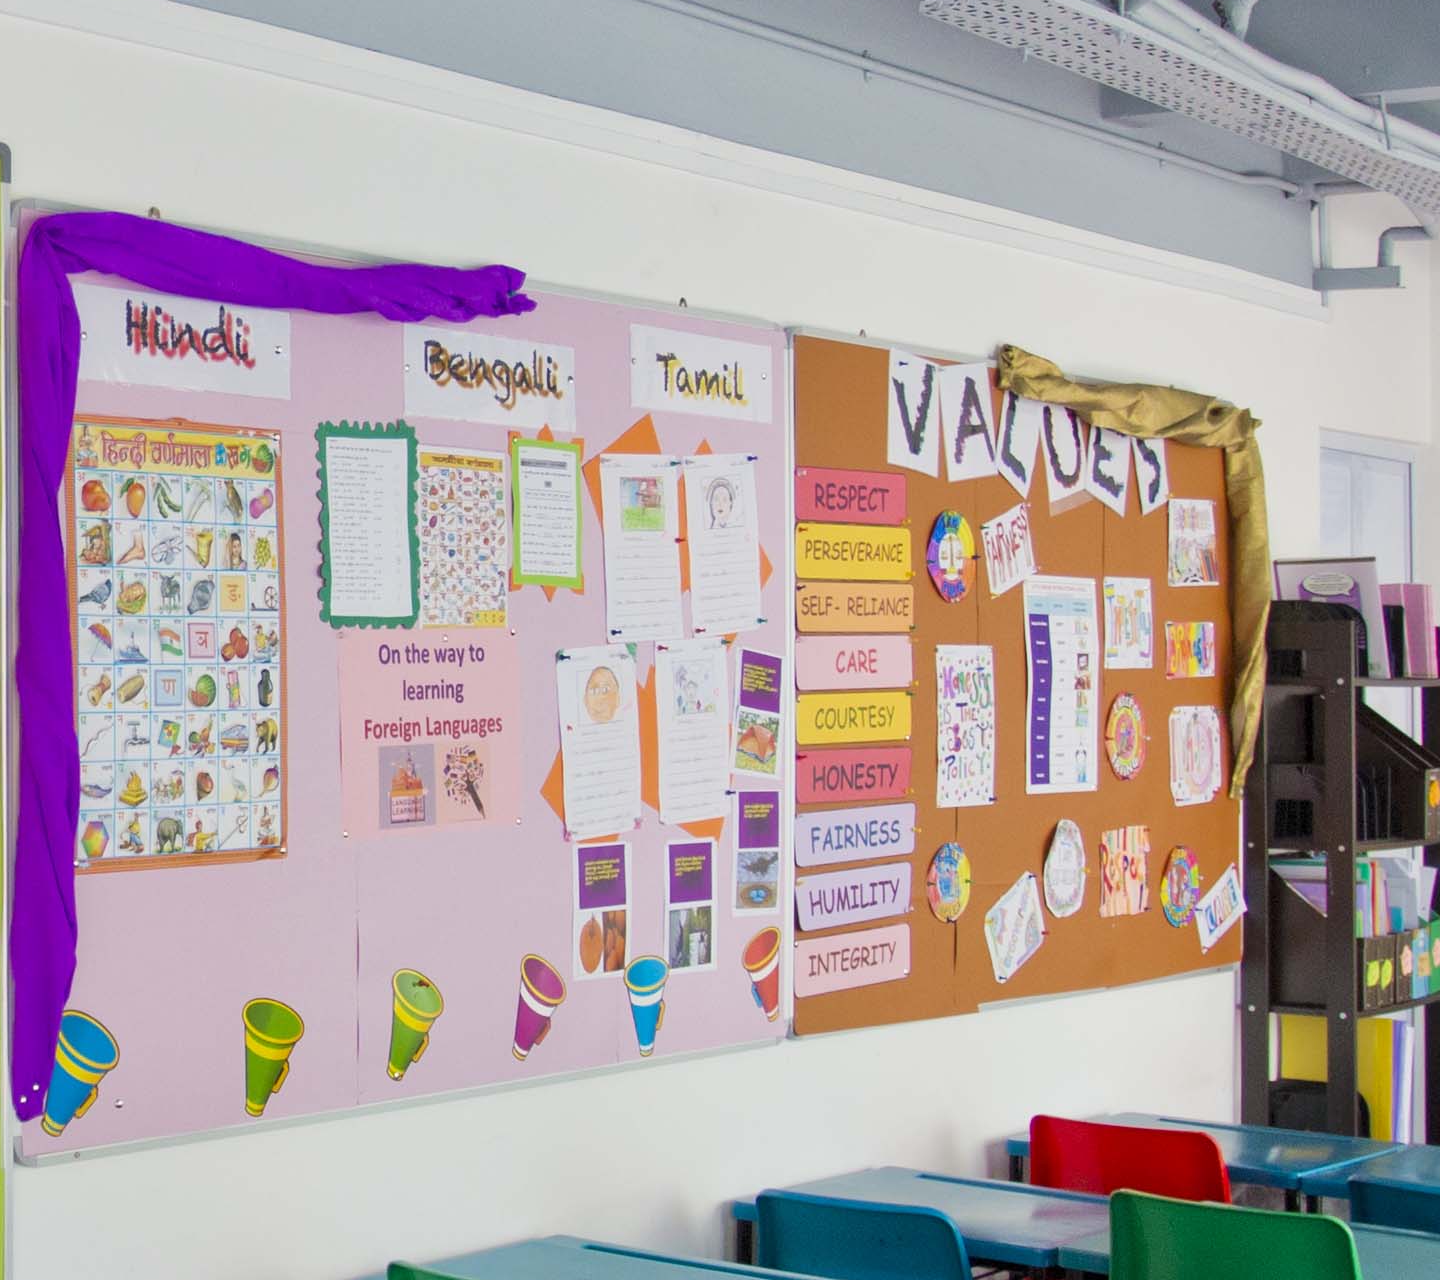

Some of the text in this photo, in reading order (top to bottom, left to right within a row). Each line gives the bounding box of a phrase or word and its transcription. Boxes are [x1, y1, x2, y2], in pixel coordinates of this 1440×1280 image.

[126, 299, 255, 368] Hindi
[424, 340, 562, 410] Bengali
[656, 352, 747, 405] Tamil
[892, 364, 1161, 504] VALUES
[101, 431, 211, 468] हिन्दी वर्णमाला
[815, 483, 889, 512] RESPECT
[805, 540, 903, 563] PERSEVERANCE
[847, 597, 909, 617] RELIANCE
[378, 643, 485, 667] On the way to
[836, 649, 877, 673] CARE
[403, 679, 464, 703] learning
[364, 716, 503, 741] Foreign Languages
[815, 706, 895, 730] COURTESY
[812, 763, 898, 792] HONESTY
[811, 820, 900, 854] FAIRNESS
[810, 878, 900, 916] HUMILITY
[808, 941, 896, 978] INTEGRITY
